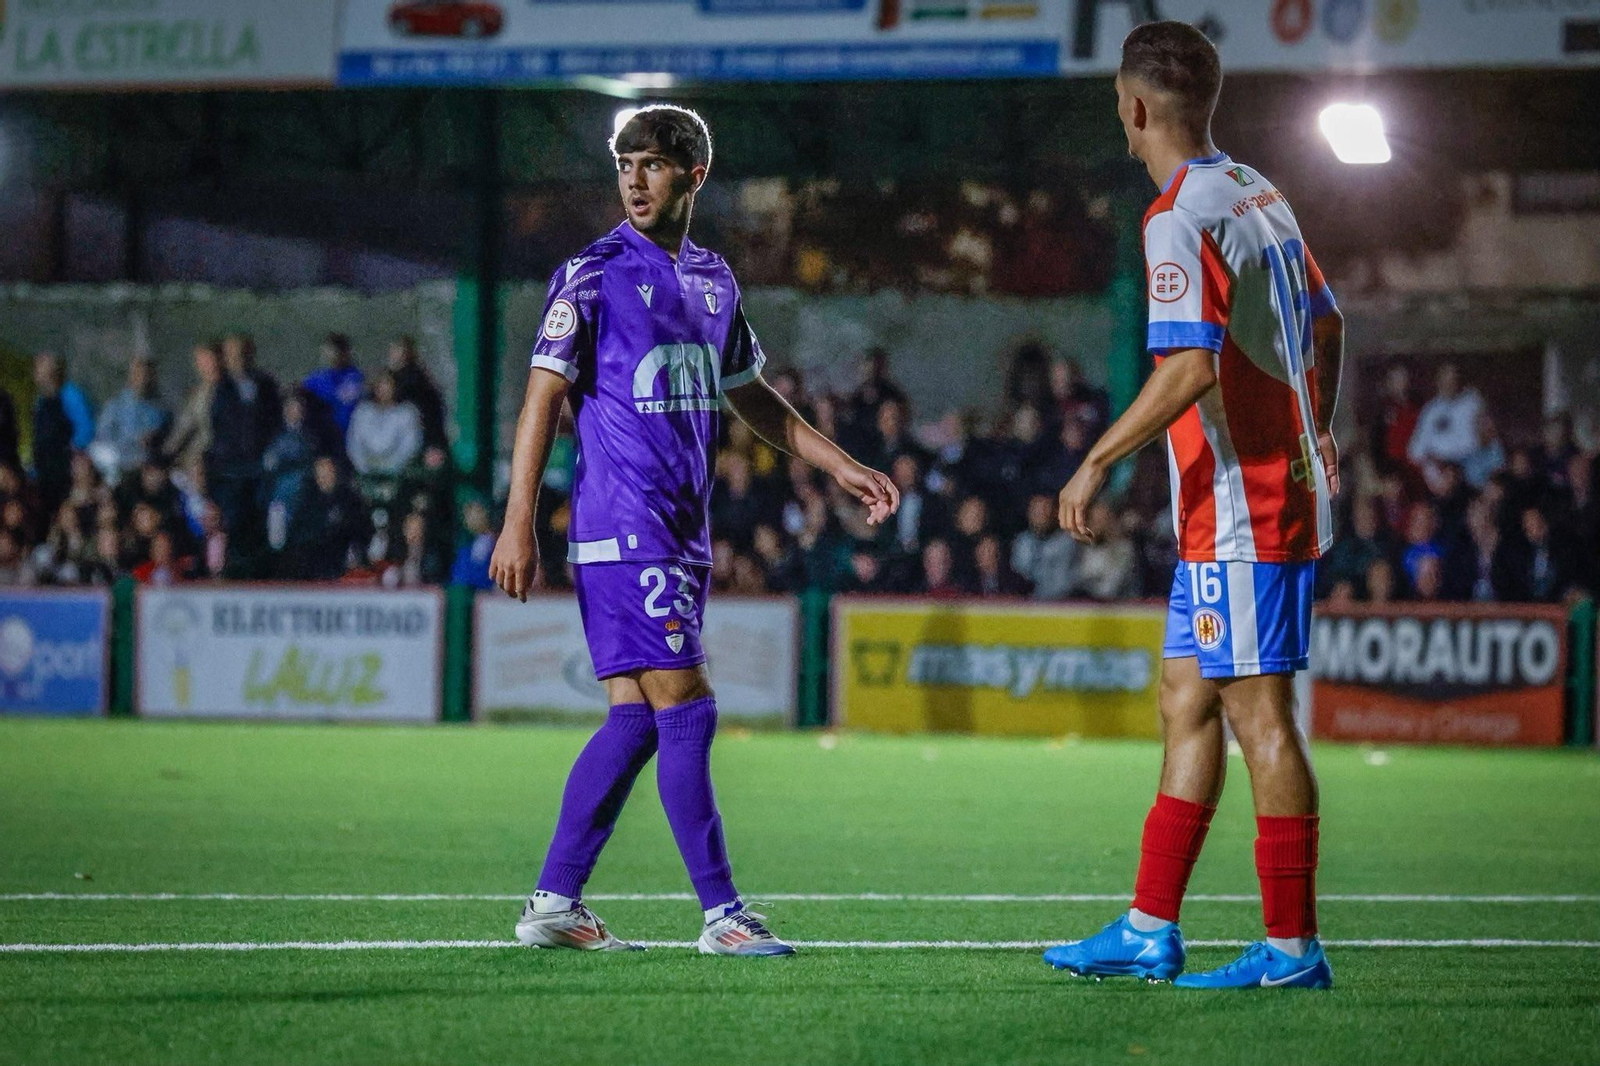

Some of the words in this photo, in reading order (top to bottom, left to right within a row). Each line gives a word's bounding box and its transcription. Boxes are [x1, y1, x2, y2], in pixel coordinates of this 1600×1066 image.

[639, 566, 695, 618] 23
[1187, 561, 1222, 606] 16
[211, 601, 431, 637] ELECTRICIDAD
[906, 643, 1152, 699] masymas
